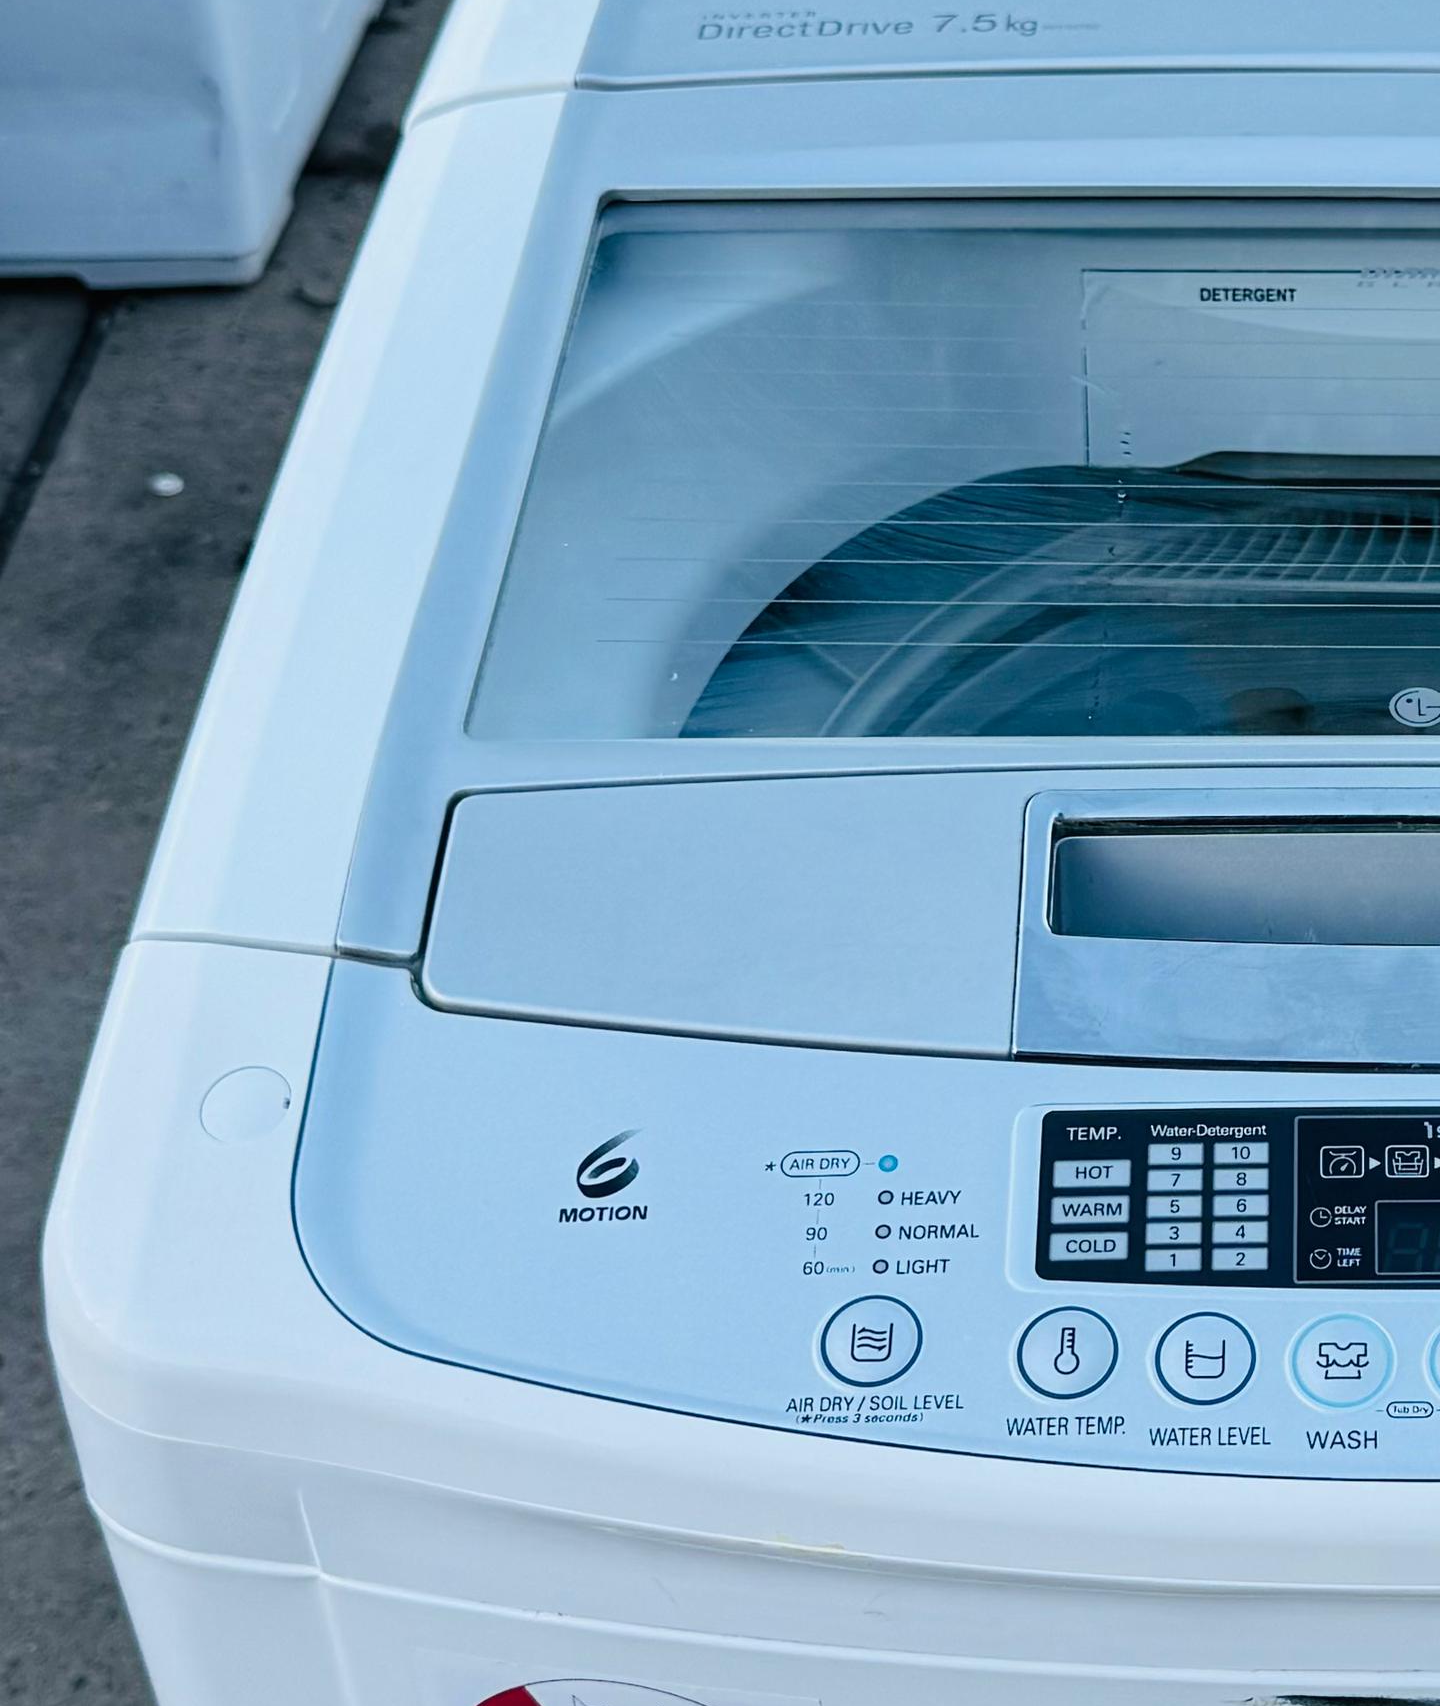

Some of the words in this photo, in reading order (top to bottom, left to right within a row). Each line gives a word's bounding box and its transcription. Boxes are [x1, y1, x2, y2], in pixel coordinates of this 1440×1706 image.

[931, 13, 998, 34] 7.5
[1005, 13, 1038, 37] kg
[1199, 287, 1297, 303] DETERGENT
[1066, 1126, 1122, 1142] TEMP.
[1150, 1124, 1267, 1139] Water-Detergent
[1170, 1146, 1182, 1161] 9
[1231, 1145, 1251, 1160] 10
[788, 1157, 816, 1171] AIR
[819, 1156, 852, 1170] DRY
[1075, 1165, 1115, 1180] HOT
[1235, 1172, 1248, 1187] 8
[1170, 1173, 1181, 1188] 7
[804, 1192, 835, 1207] 120
[900, 1190, 962, 1206] HEAVY
[1235, 1198, 1248, 1213] 6
[1061, 1202, 1123, 1218] WARM
[1169, 1199, 1181, 1214] 5
[1333, 1204, 1367, 1215] DELAY
[558, 1205, 648, 1224] MOTION
[1333, 1215, 1367, 1226] START
[805, 1226, 828, 1241] 90
[898, 1224, 980, 1241] NORMAL
[1168, 1225, 1181, 1240] 3
[1234, 1224, 1246, 1239] 4
[1065, 1238, 1117, 1254] COLD
[1336, 1247, 1363, 1257] TIME
[895, 1258, 951, 1276] LIGHT
[1169, 1253, 1178, 1268] 1
[1234, 1252, 1247, 1267] 2
[1336, 1258, 1362, 1268] LEFT
[785, 1397, 814, 1413] AIR
[819, 1396, 854, 1412] DRY
[869, 1395, 908, 1411] SOIL
[914, 1394, 964, 1410] LEVEL
[852, 1413, 861, 1424] 3
[1005, 1417, 1069, 1437] WATER
[1074, 1415, 1127, 1436] TEMP.
[1149, 1427, 1213, 1447] WATER
[1217, 1426, 1271, 1446] LEVEL
[1305, 1429, 1379, 1452] WASH
